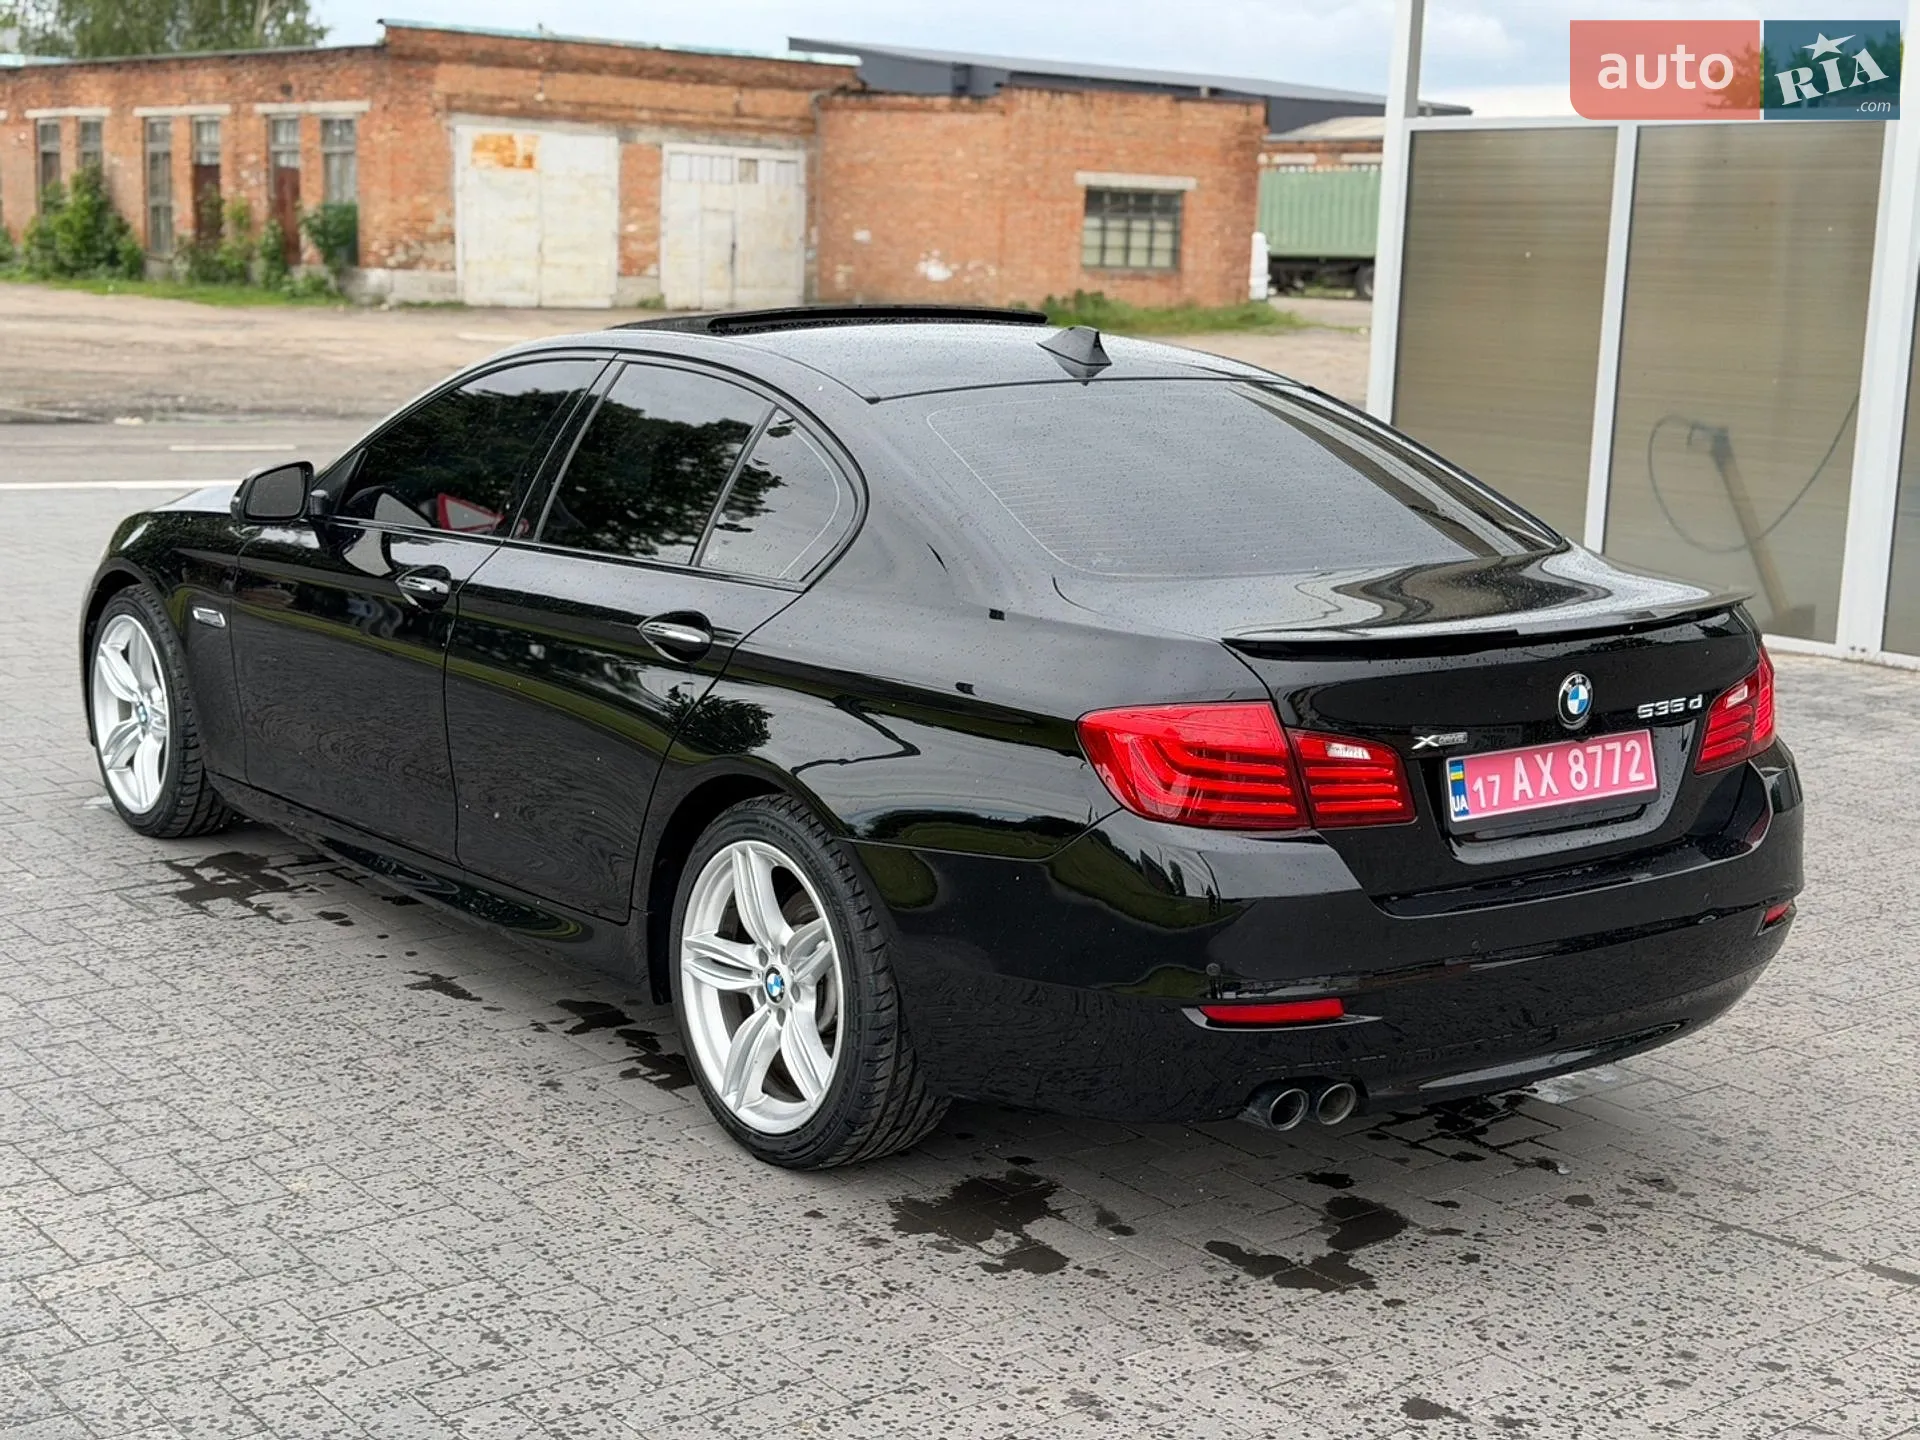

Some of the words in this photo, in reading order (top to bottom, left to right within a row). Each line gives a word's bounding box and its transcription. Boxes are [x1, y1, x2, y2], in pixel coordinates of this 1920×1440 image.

[1472, 774, 1500, 808] 17
[1512, 752, 1559, 801] AX
[1568, 739, 1646, 791] 8772
[1451, 795, 1468, 812] UA
